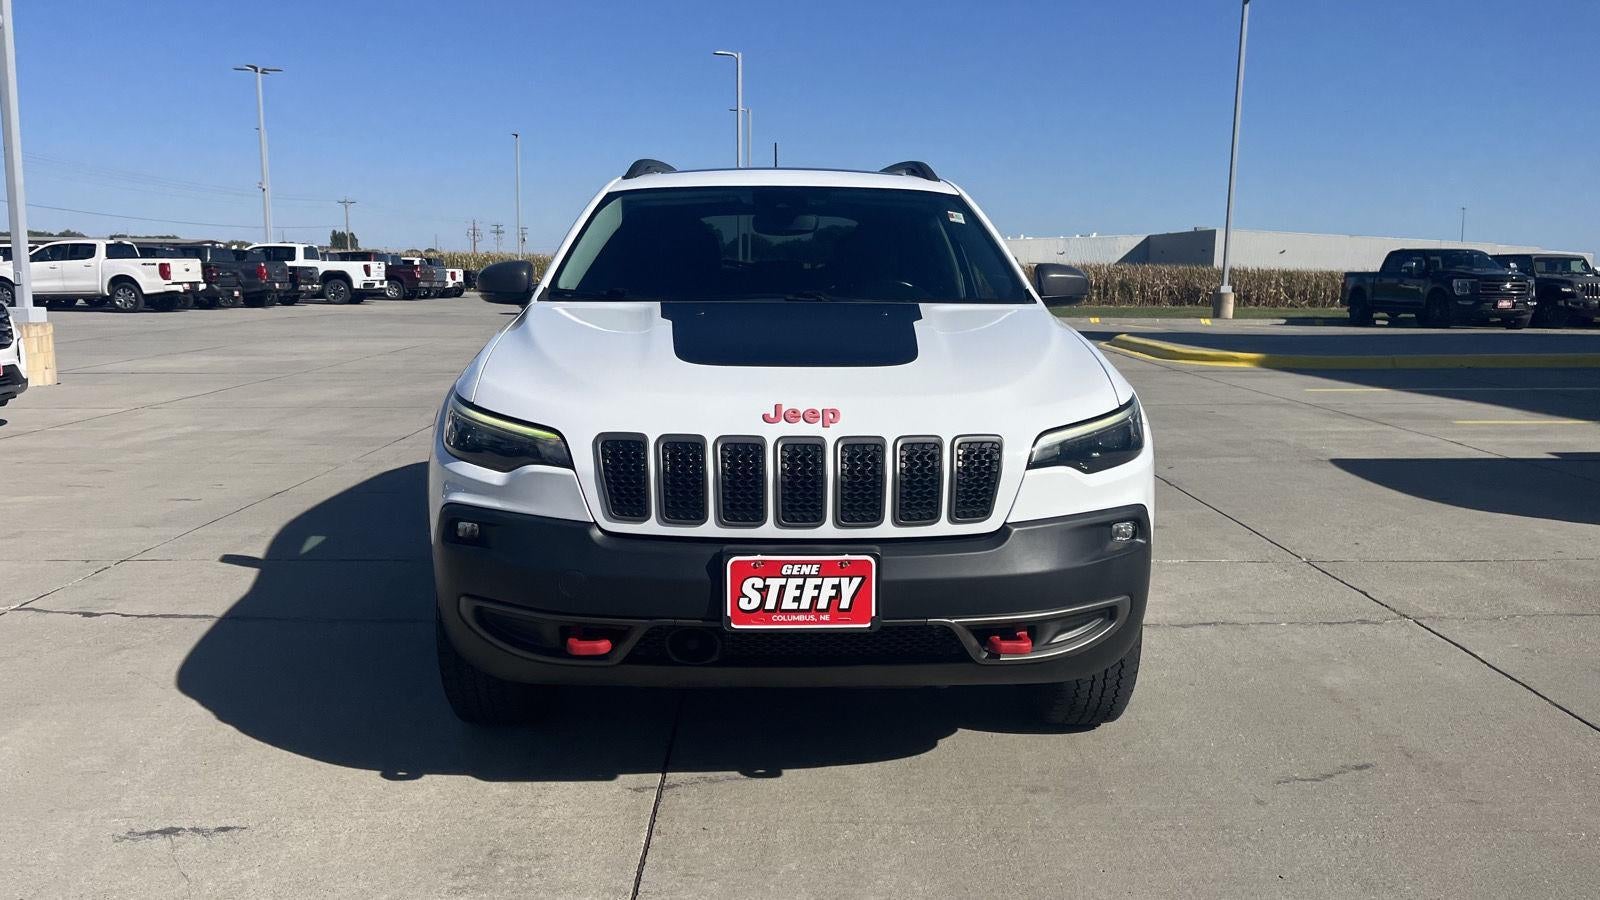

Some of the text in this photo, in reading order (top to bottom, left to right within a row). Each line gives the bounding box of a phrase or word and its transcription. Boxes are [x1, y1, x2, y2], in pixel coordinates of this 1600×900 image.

[762, 404, 840, 428] Jeep
[781, 564, 821, 576] GENE
[738, 577, 863, 611] STEFFY
[771, 614, 818, 622] COLUMBUS,
